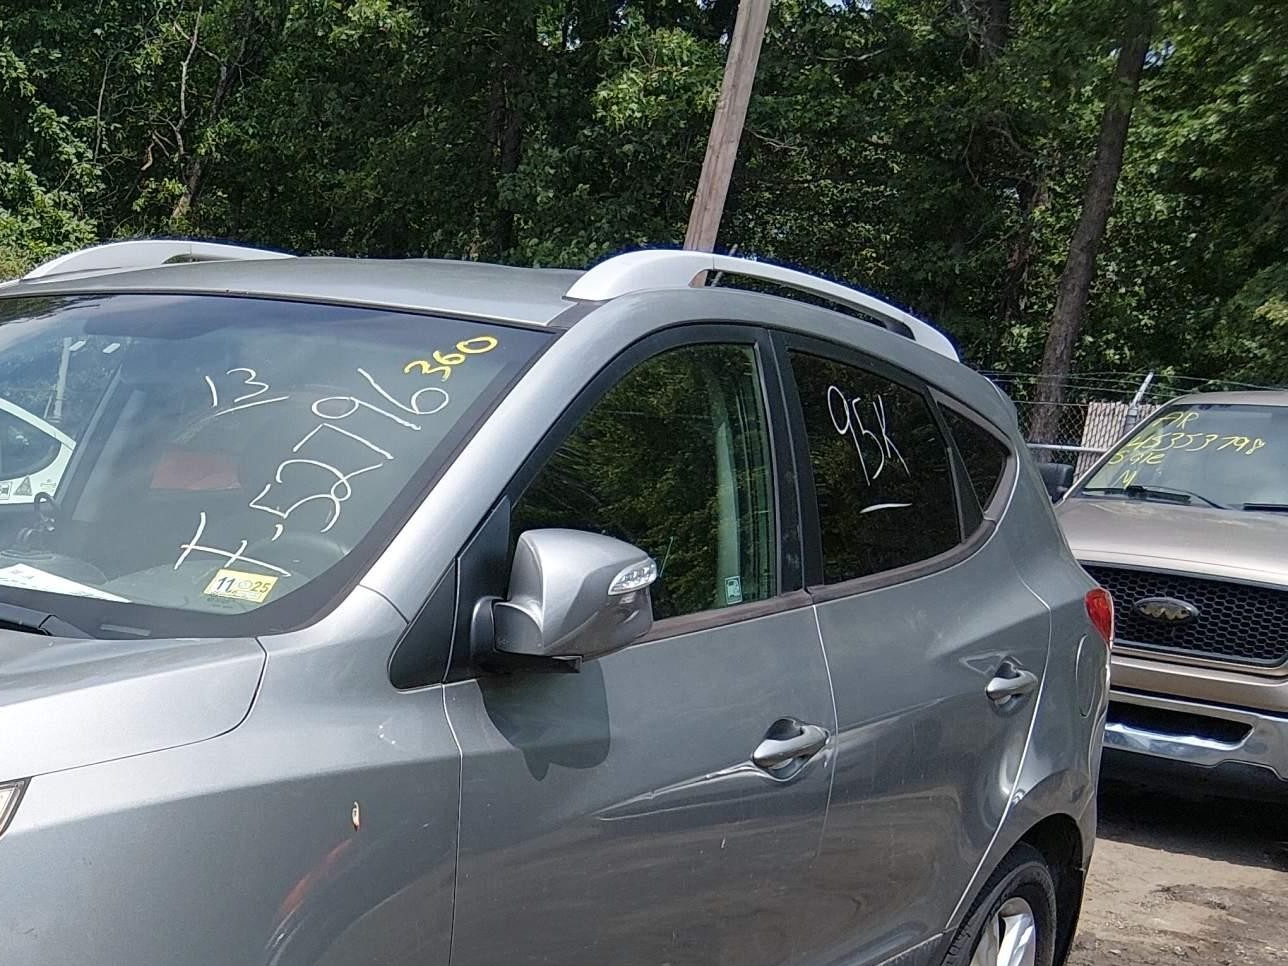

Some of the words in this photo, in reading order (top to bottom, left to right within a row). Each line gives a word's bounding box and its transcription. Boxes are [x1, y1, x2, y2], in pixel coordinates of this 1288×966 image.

[405, 335, 498, 382] 360
[205, 367, 270, 408] 13
[827, 385, 910, 486] 95K
[216, 576, 236, 593] 11
[250, 580, 272, 594] 25
